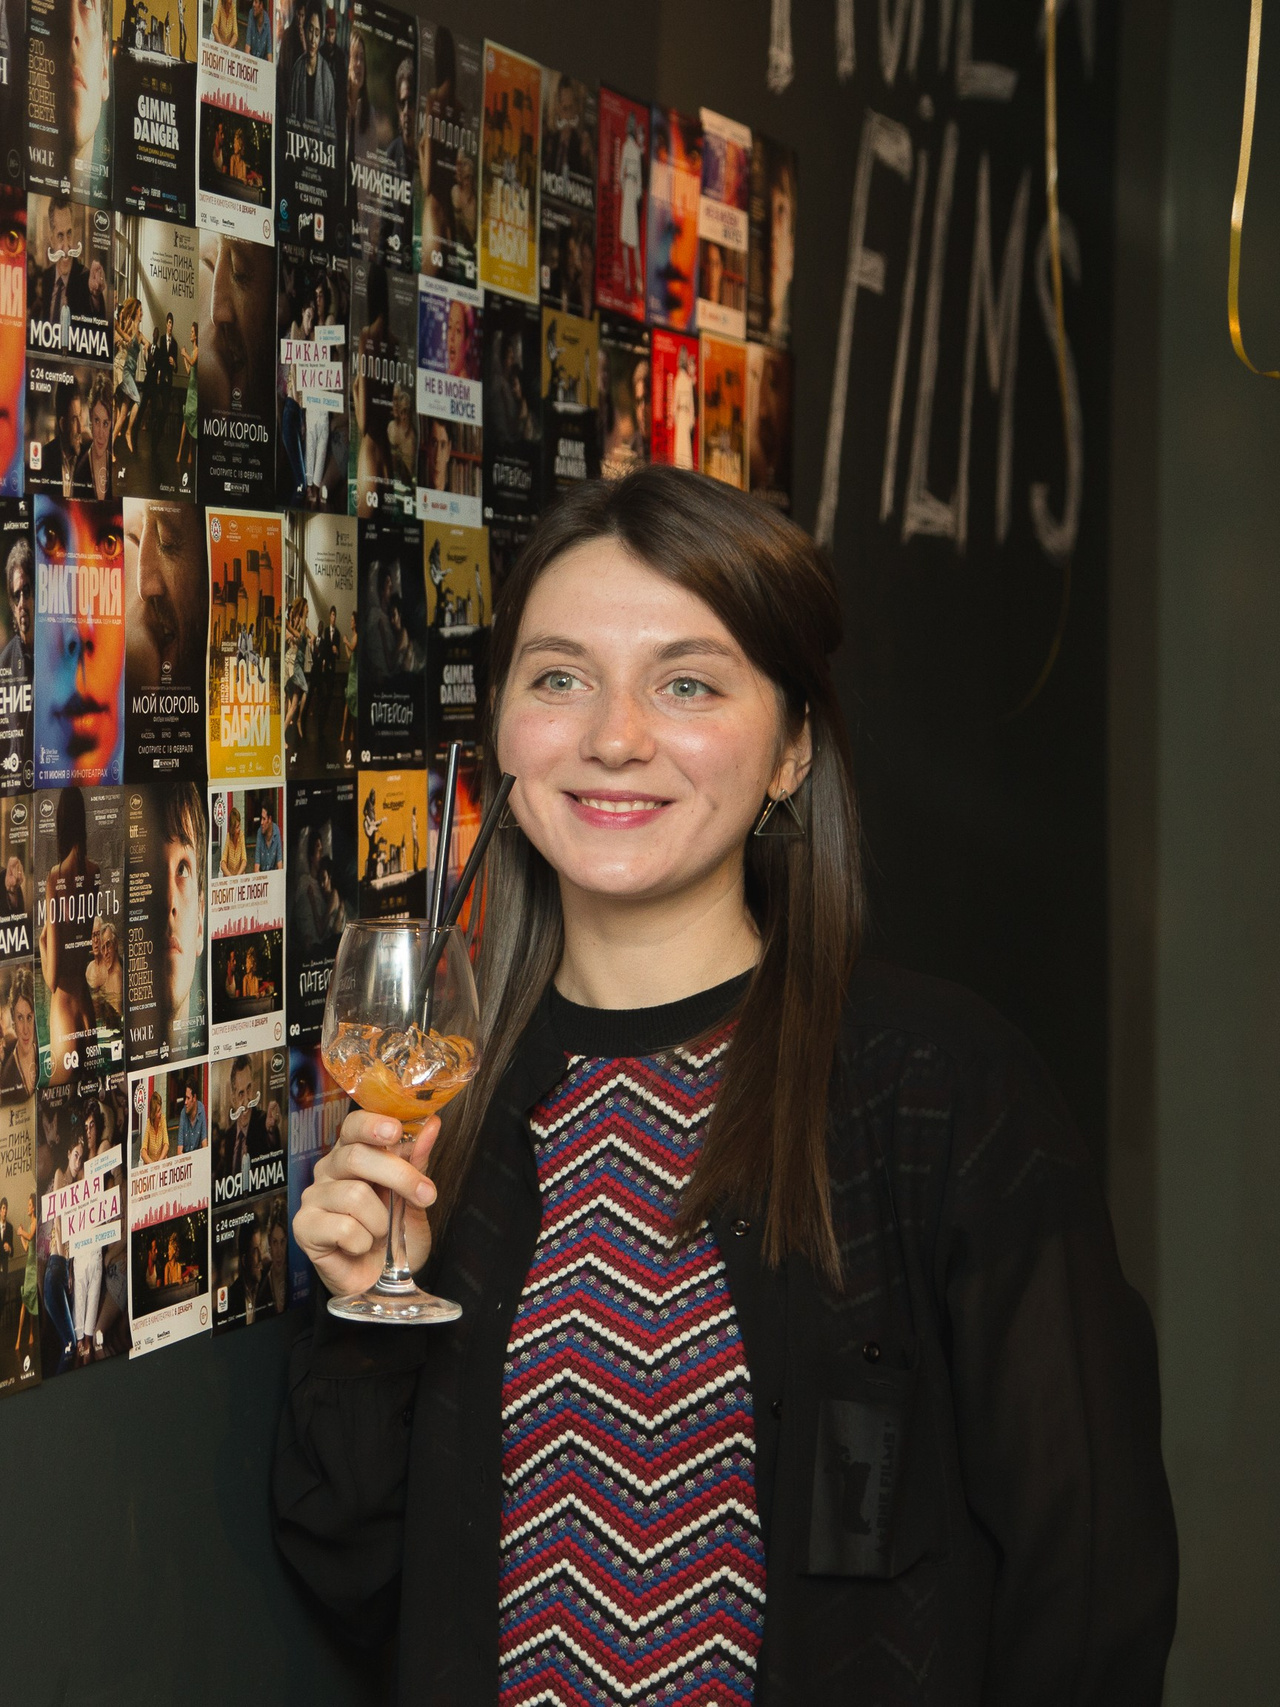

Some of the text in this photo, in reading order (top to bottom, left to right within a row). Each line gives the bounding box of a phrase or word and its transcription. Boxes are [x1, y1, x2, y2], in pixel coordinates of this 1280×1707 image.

[29, 37, 45, 56] ЭТО
[28, 54, 56, 75] ВСЕГО
[201, 50, 224, 69] ЛЮБИТ
[227, 60, 236, 76] НЕ
[235, 62, 259, 85] ЛЮБИТ
[28, 70, 51, 90] ЛИШЬ
[28, 86, 56, 109] КОНЕЦ
[28, 102, 56, 124] СВЕТА
[137, 95, 176, 126] GIMME
[133, 117, 180, 151] DANGER
[419, 111, 477, 156] МОЛОДОСТЬ
[28, 146, 55, 168] VOGUE
[285, 130, 336, 169] ДРУЗЬЯ
[350, 161, 411, 206] УНИЖЕНИЕ
[431, 250, 443, 267] GQ
[150, 263, 195, 285] ТАНЦУЮЩИЕ
[172, 283, 195, 300] МЕЧТЫ
[30, 318, 110, 358] МОЯ МАМА
[284, 341, 329, 364] ДИКАЯ
[35, 367, 74, 385] 24 сентября
[302, 368, 342, 388] КИСКА
[352, 352, 414, 388] МОЛОДОСТЬ
[424, 379, 471, 401] НЕ МОЁМ
[450, 401, 476, 420] ВКУСЕ
[203, 418, 269, 443] МОЙ КОРОЛЬ
[209, 466, 233, 478] СМОТРИТЕ
[492, 461, 532, 490] ПАТЕРСОН
[366, 491, 378, 508] GQ
[314, 563, 354, 580] ТАНЦУЮЩИЕ
[38, 563, 122, 616] ВИКТОРИЯ
[334, 577, 354, 590] МЕЧТЫ
[229, 657, 270, 704] ГОНИ
[442, 665, 475, 684] GIMME
[132, 692, 199, 715] МОЙ КОРОЛЬ
[440, 684, 477, 704] DANGER
[220, 705, 271, 747] БАБКИ
[371, 703, 413, 727] ПАТЕРСОН
[138, 745, 163, 755] СМОТРИТЕ
[71, 767, 108, 779] КИНОТЕАТРАХ
[211, 882, 269, 906] ЛЮБИТ НЕ ЛЮБИТ
[37, 889, 120, 926] МОЛОДОСТЬ
[128, 926, 144, 943] ЭТО
[128, 940, 154, 958] ВСЕГО
[128, 957, 149, 973] ЛИШЬ
[128, 970, 154, 988] КОНЕЦ
[128, 985, 154, 1003] СВЕТА
[129, 1024, 154, 1042] VOGUE
[290, 1023, 300, 1036] GQ
[64, 1050, 79, 1070] GQ
[5, 1159, 32, 1179] МЕЧТЫ
[131, 1163, 193, 1196] ЛЮБИТ НЕ ЛЮБИТ
[216, 1161, 285, 1202] МОЯ МАМА
[47, 1176, 102, 1220] ДИКАЯ
[68, 1196, 119, 1236] КИСКА
[220, 1211, 255, 1230] 24 сентября
[879, 1432, 895, 1488] FILMS
